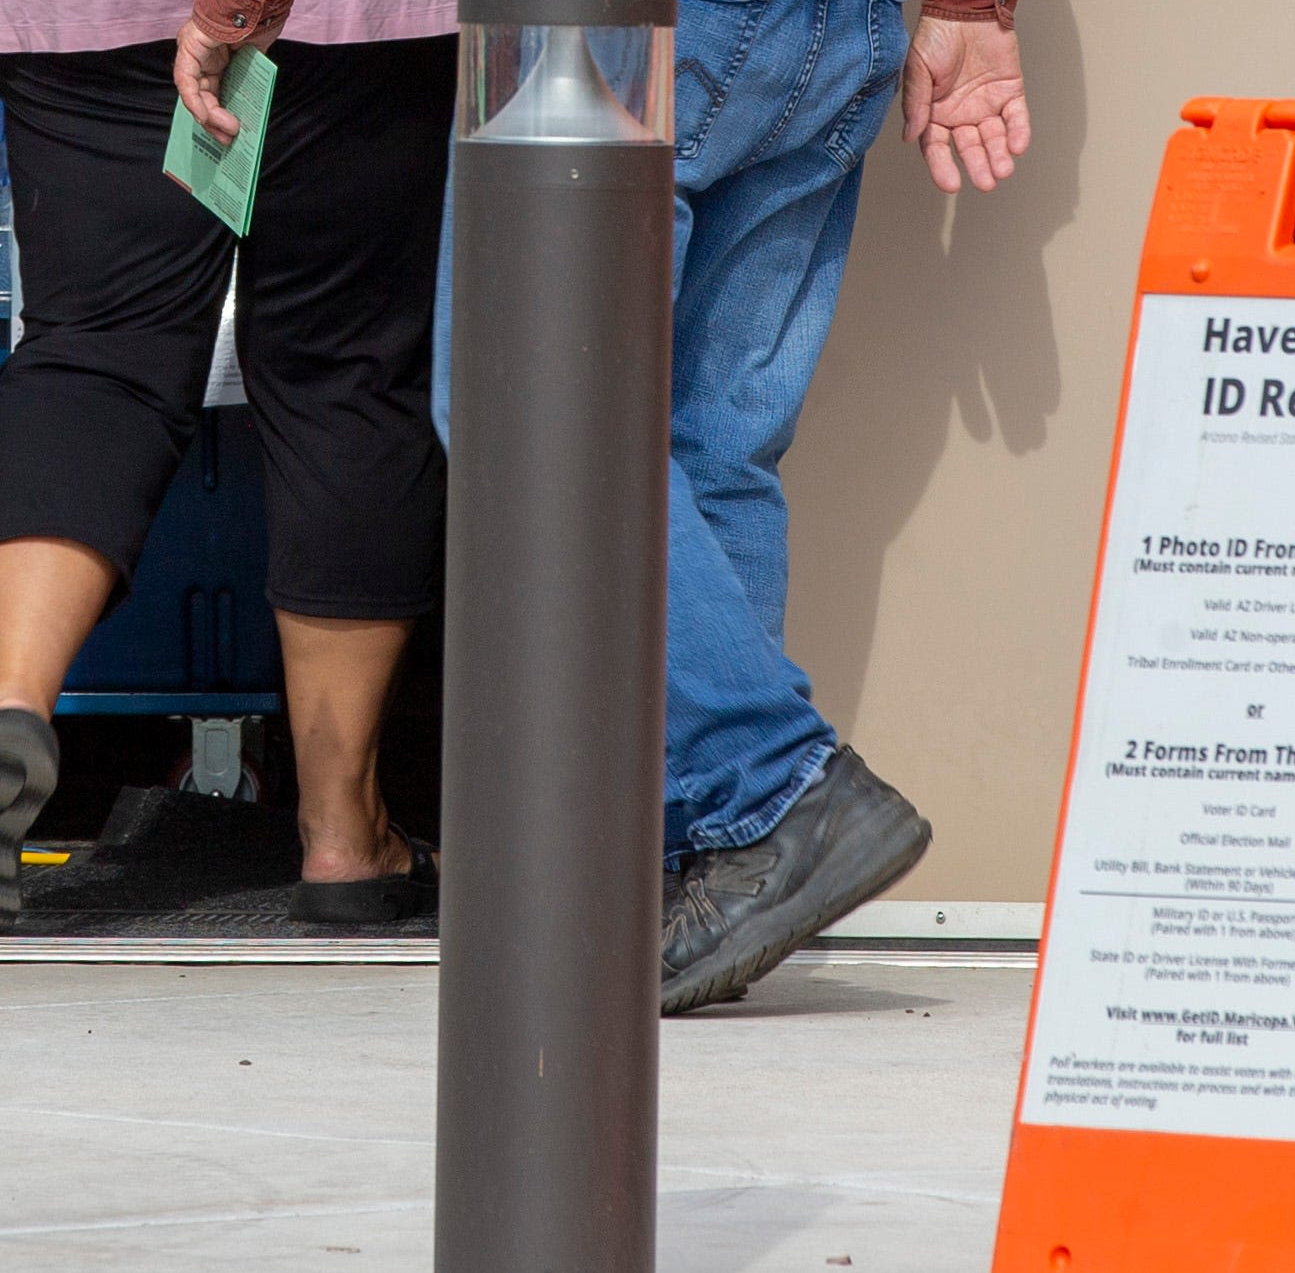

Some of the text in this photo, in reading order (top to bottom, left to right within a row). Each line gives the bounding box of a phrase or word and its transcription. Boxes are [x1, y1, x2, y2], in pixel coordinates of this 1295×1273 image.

[1202, 377, 1246, 416] ID
[1142, 535, 1152, 555] 1
[1159, 535, 1221, 557] Photo
[1226, 538, 1248, 558] ID
[1133, 558, 1175, 574] (Must
[1178, 561, 1232, 574] contain
[1234, 564, 1288, 577] current
[1246, 704, 1265, 719] or
[1125, 739, 1138, 760] 2
[1143, 740, 1208, 763] Forms
[1214, 743, 1268, 765] From
[1105, 762, 1148, 778] (Must
[1150, 765, 1205, 779] contain
[1207, 769, 1261, 782] current
[1176, 1029, 1249, 1047] for full list
